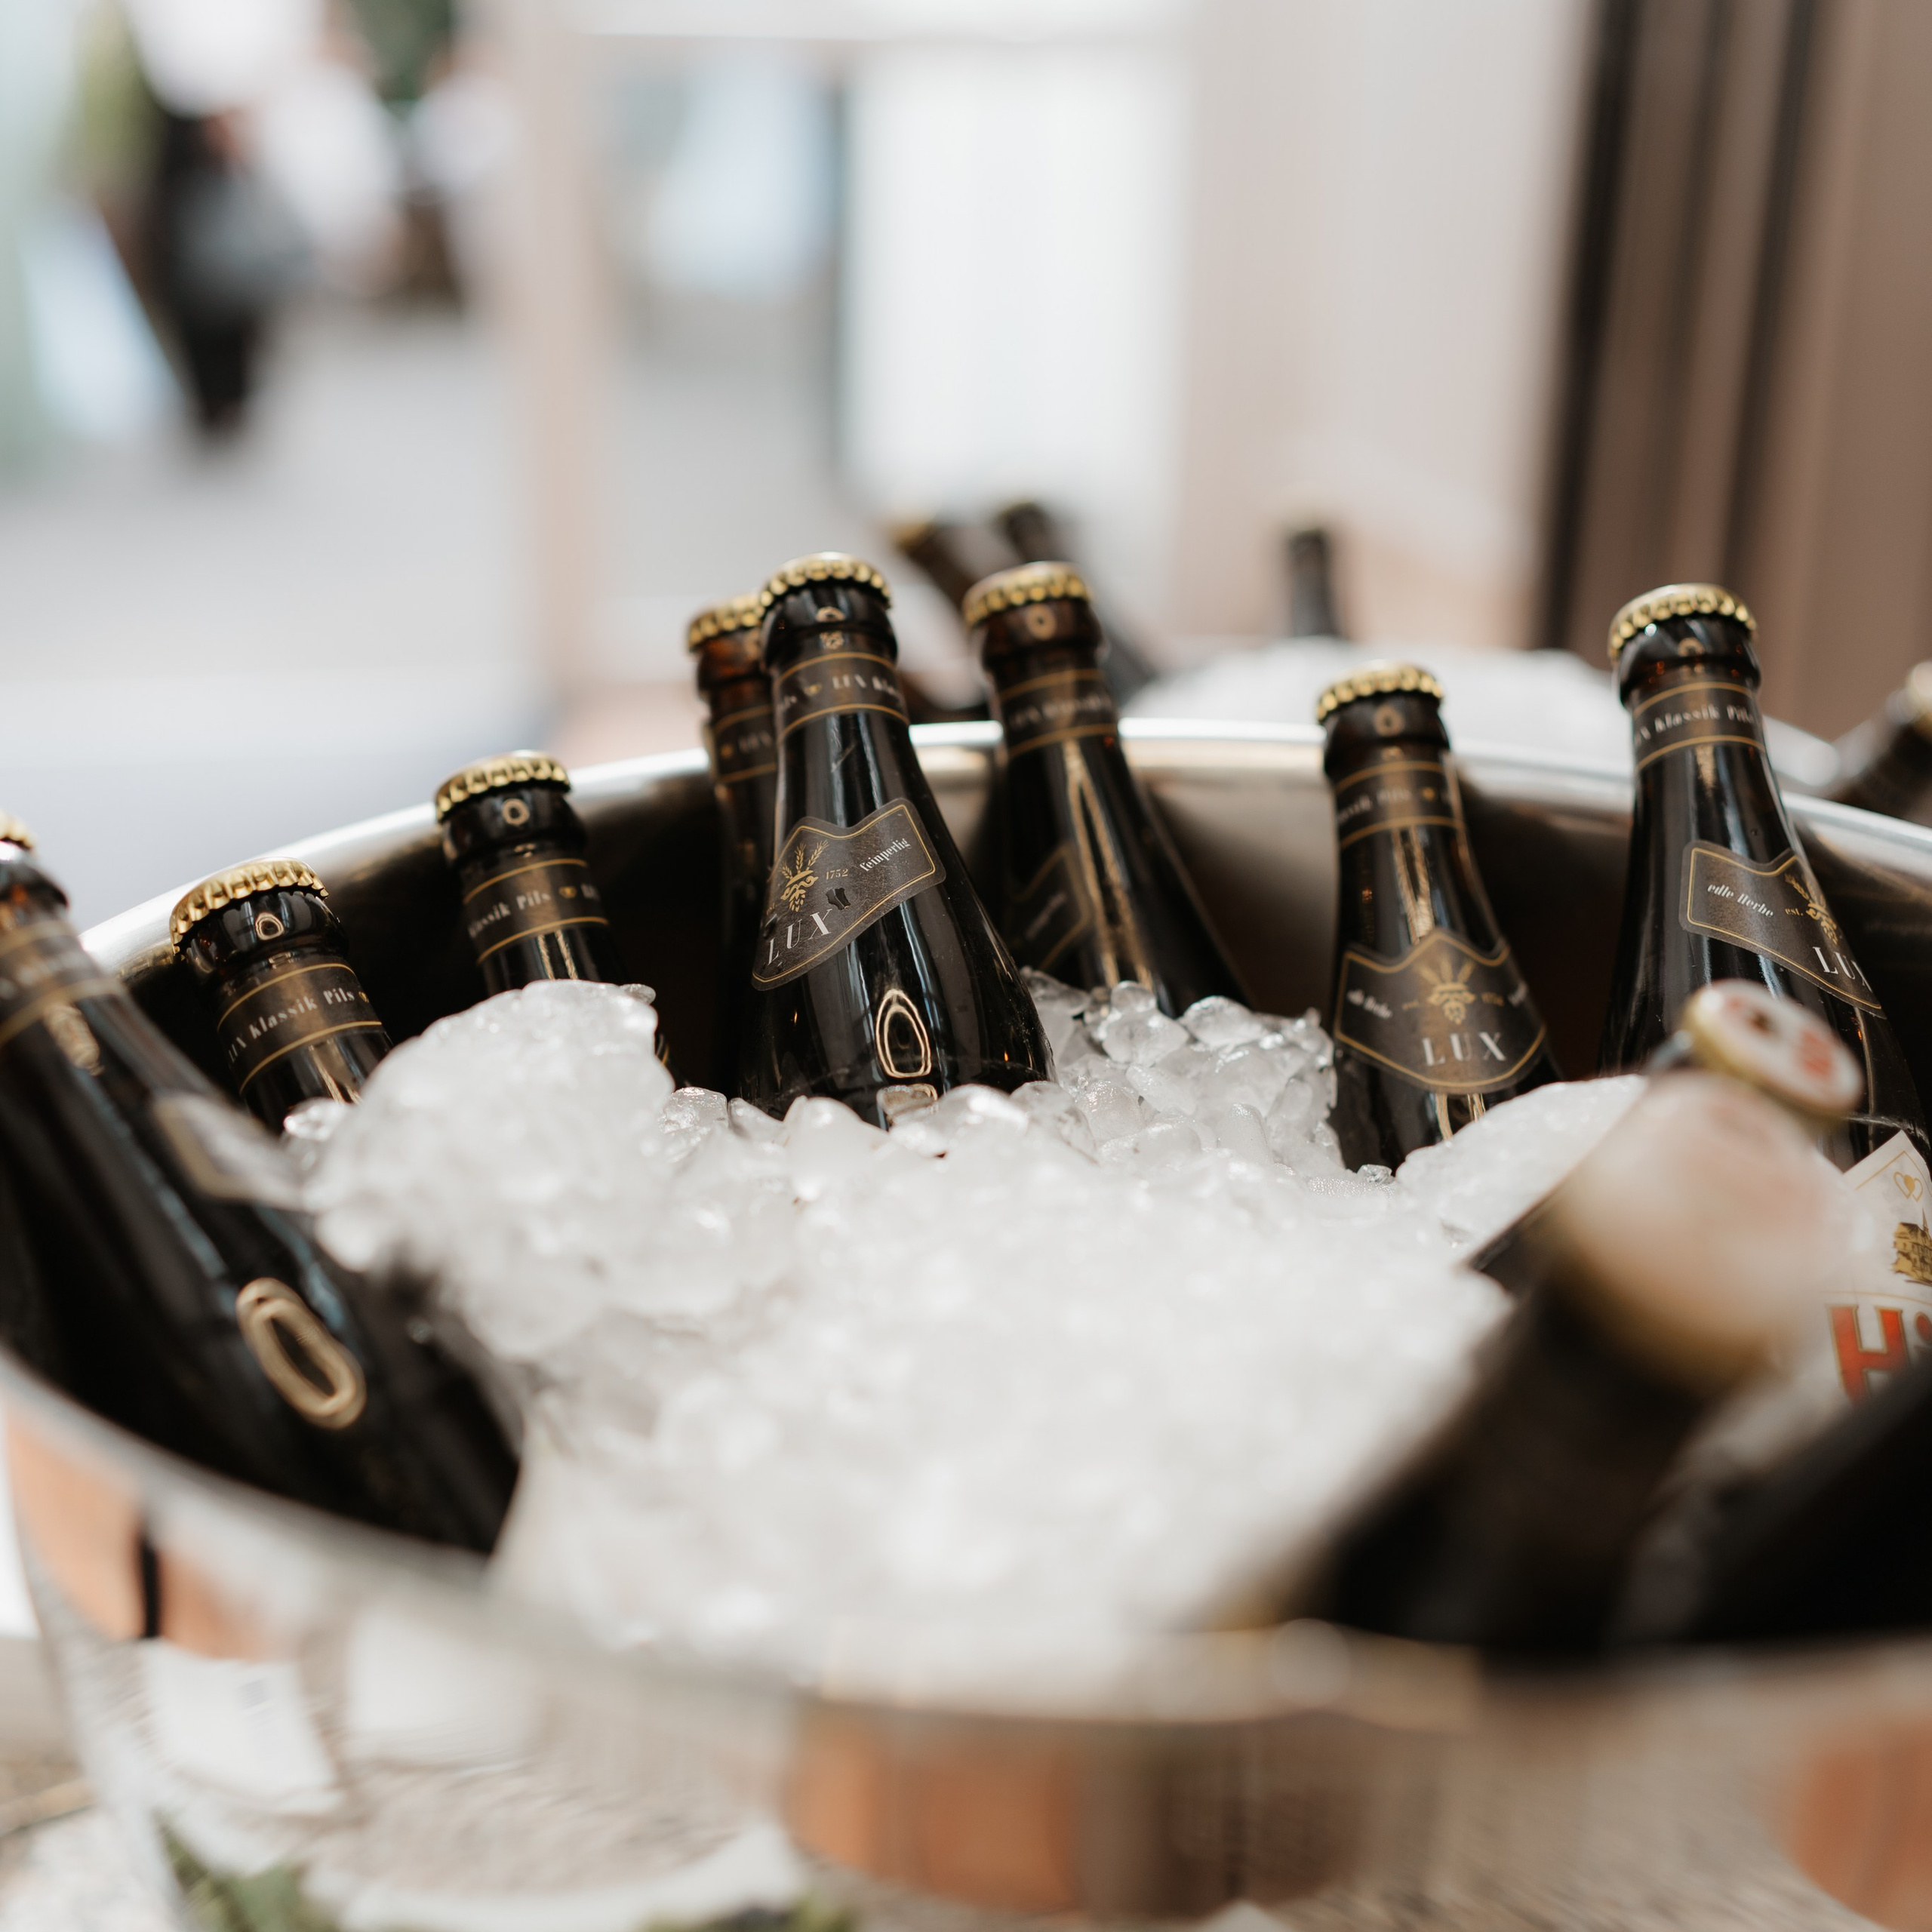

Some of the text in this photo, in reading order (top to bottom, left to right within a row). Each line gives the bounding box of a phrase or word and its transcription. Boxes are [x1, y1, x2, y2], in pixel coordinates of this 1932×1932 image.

[859, 837, 912, 872] feinperlig
[826, 868, 849, 880] 1752
[1706, 884, 1774, 918] edle Herbe
[1784, 907, 1804, 917] est.
[766, 908, 834, 967] LUX
[248, 995, 318, 1040] Klassik
[322, 986, 356, 1005] Pils
[1421, 1031, 1506, 1066] LUX
